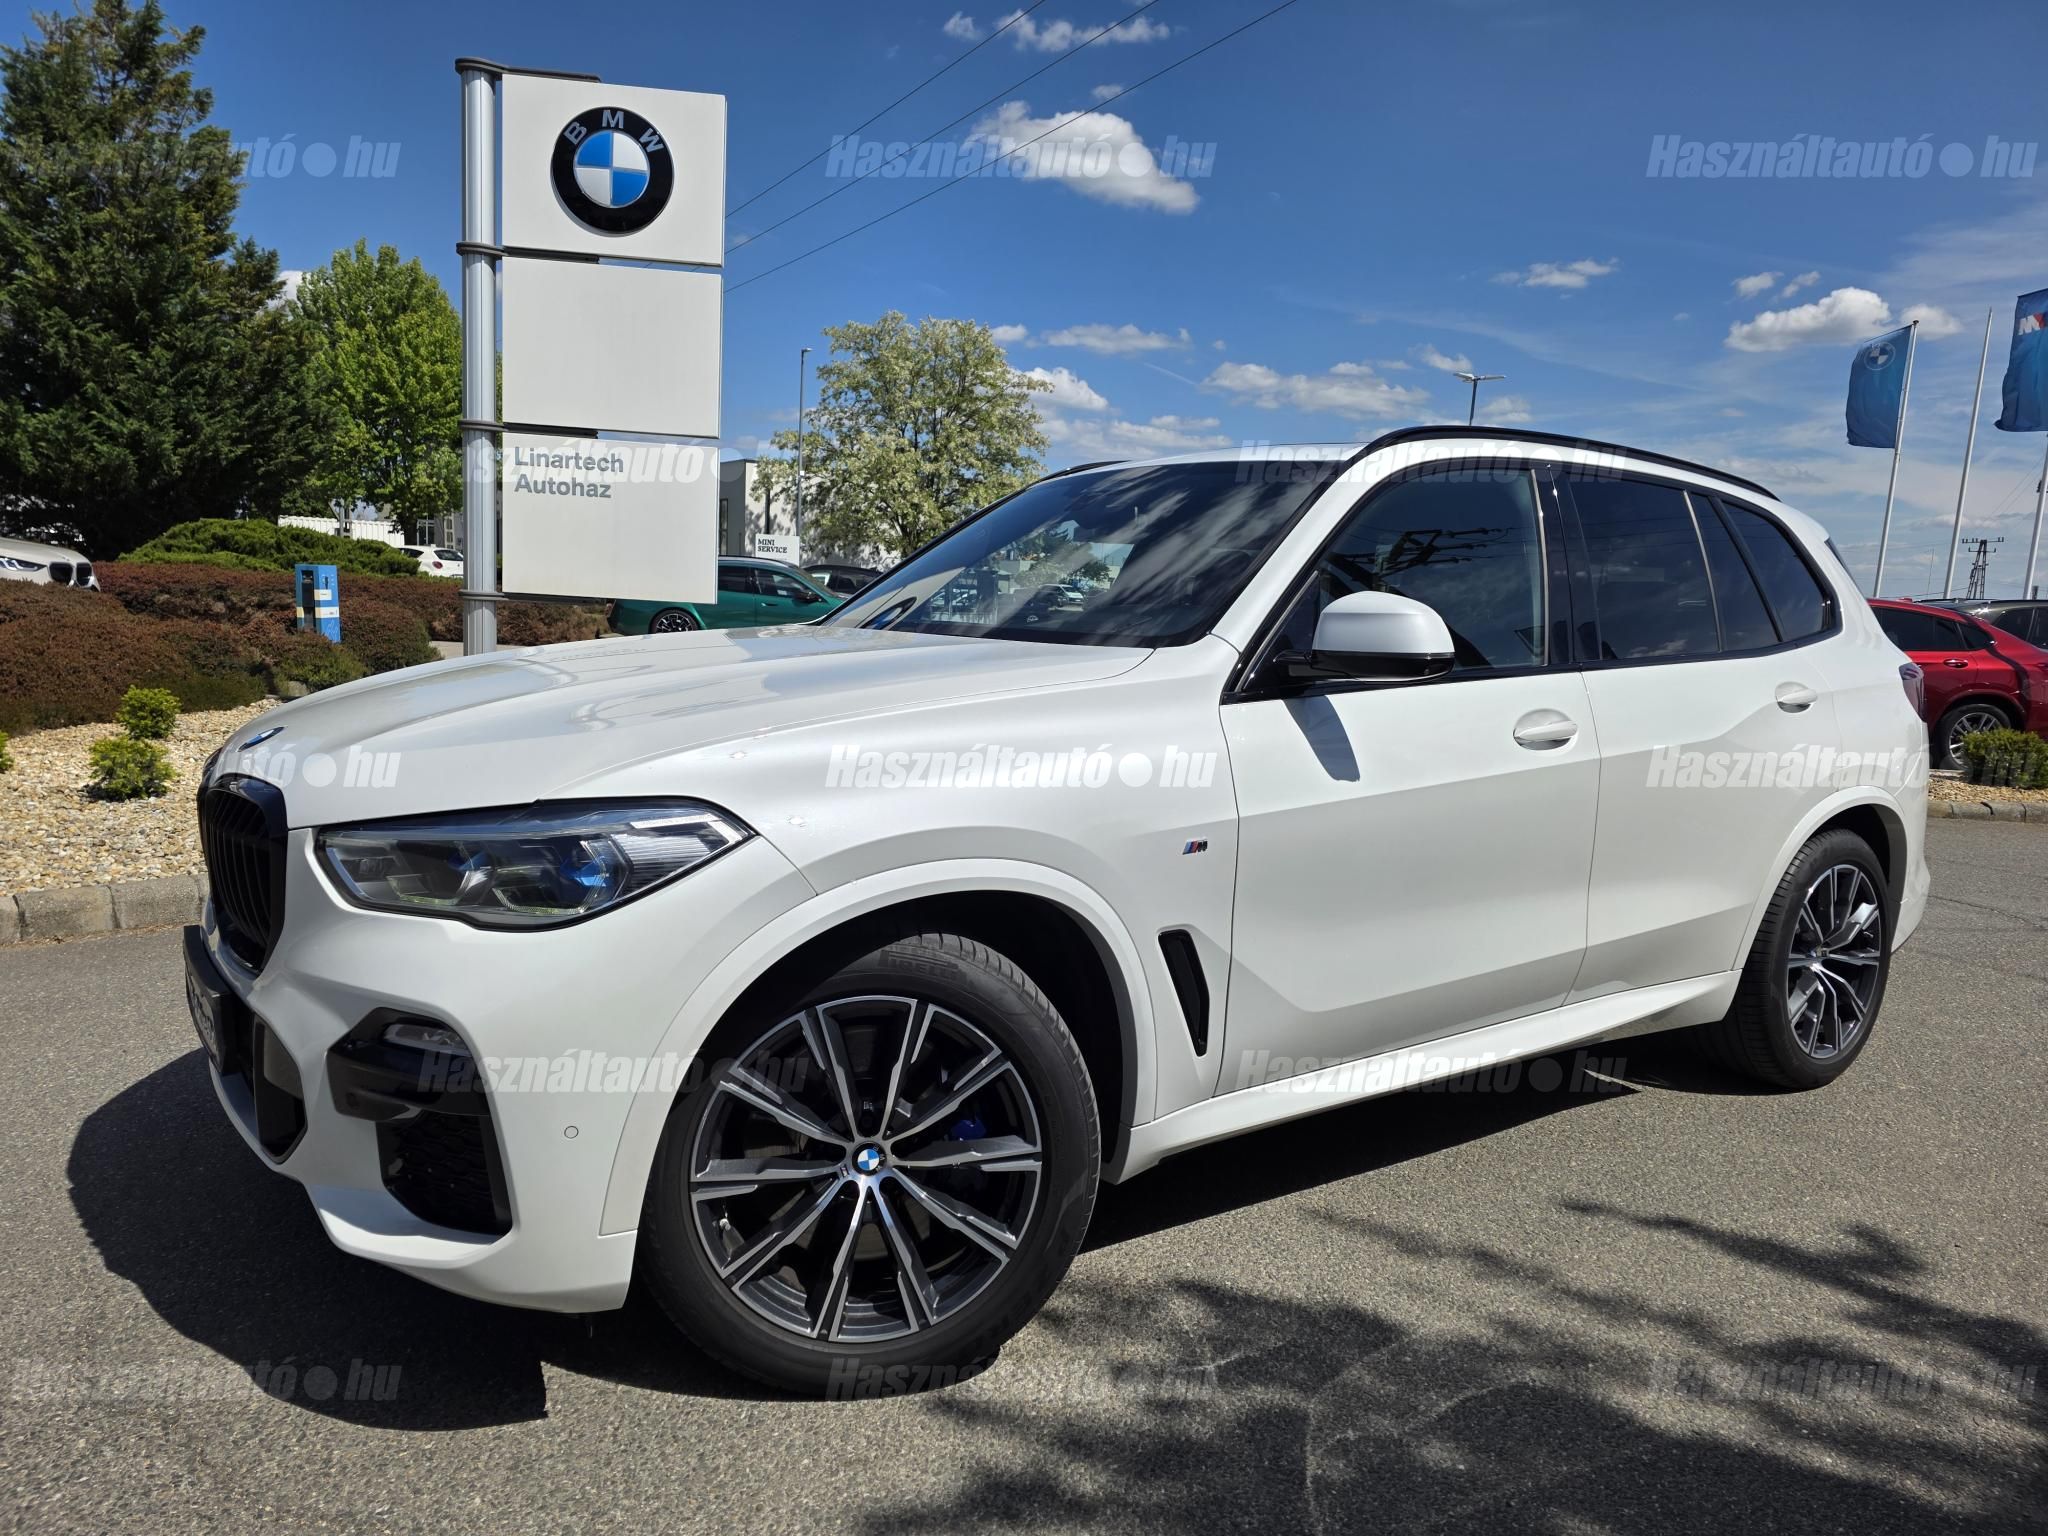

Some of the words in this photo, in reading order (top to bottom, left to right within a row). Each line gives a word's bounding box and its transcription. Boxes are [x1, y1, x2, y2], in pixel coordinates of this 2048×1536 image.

[563, 108, 664, 153] BMW
[514, 446, 624, 473] Linartech
[514, 473, 612, 498] Autohaz
[757, 538, 775, 546] MINI
[757, 545, 788, 554] SERVICE
